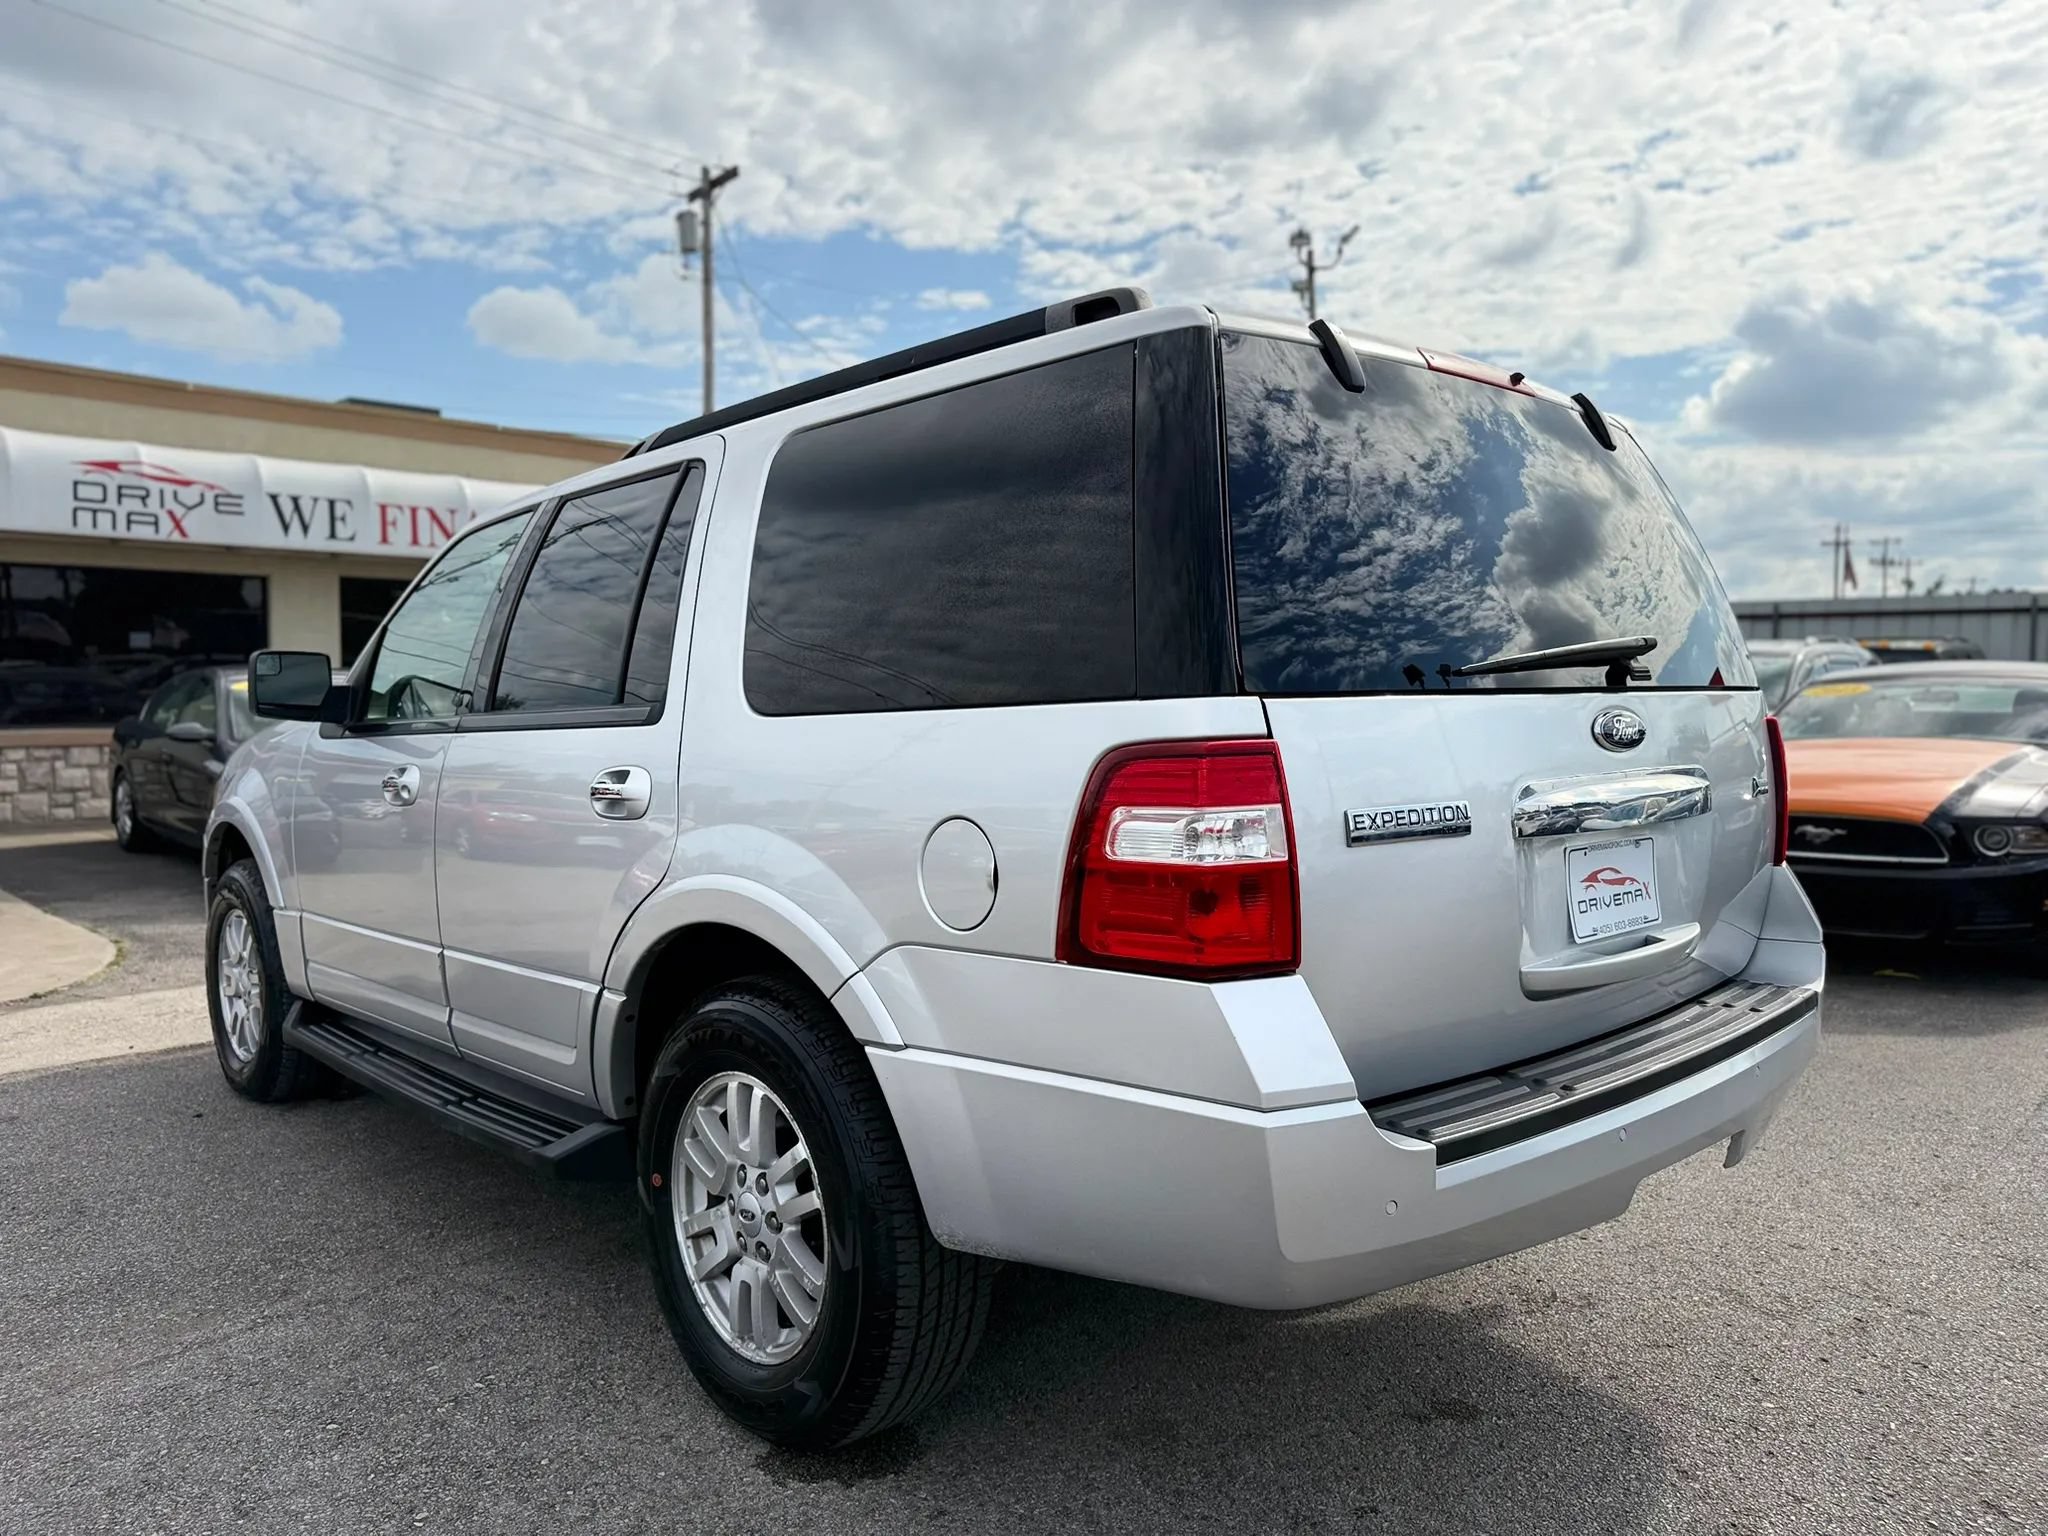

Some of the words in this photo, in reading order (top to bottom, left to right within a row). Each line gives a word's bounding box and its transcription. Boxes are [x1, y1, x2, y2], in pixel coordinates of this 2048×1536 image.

[72, 480, 244, 516] DRIVE
[72, 507, 189, 539] MAX
[267, 493, 355, 542] WE
[377, 502, 477, 547] FIN
[1613, 717, 1639, 740] Ford
[1352, 804, 1470, 831] EXPEDITION
[1578, 882, 1651, 914] DRIVEMAX
